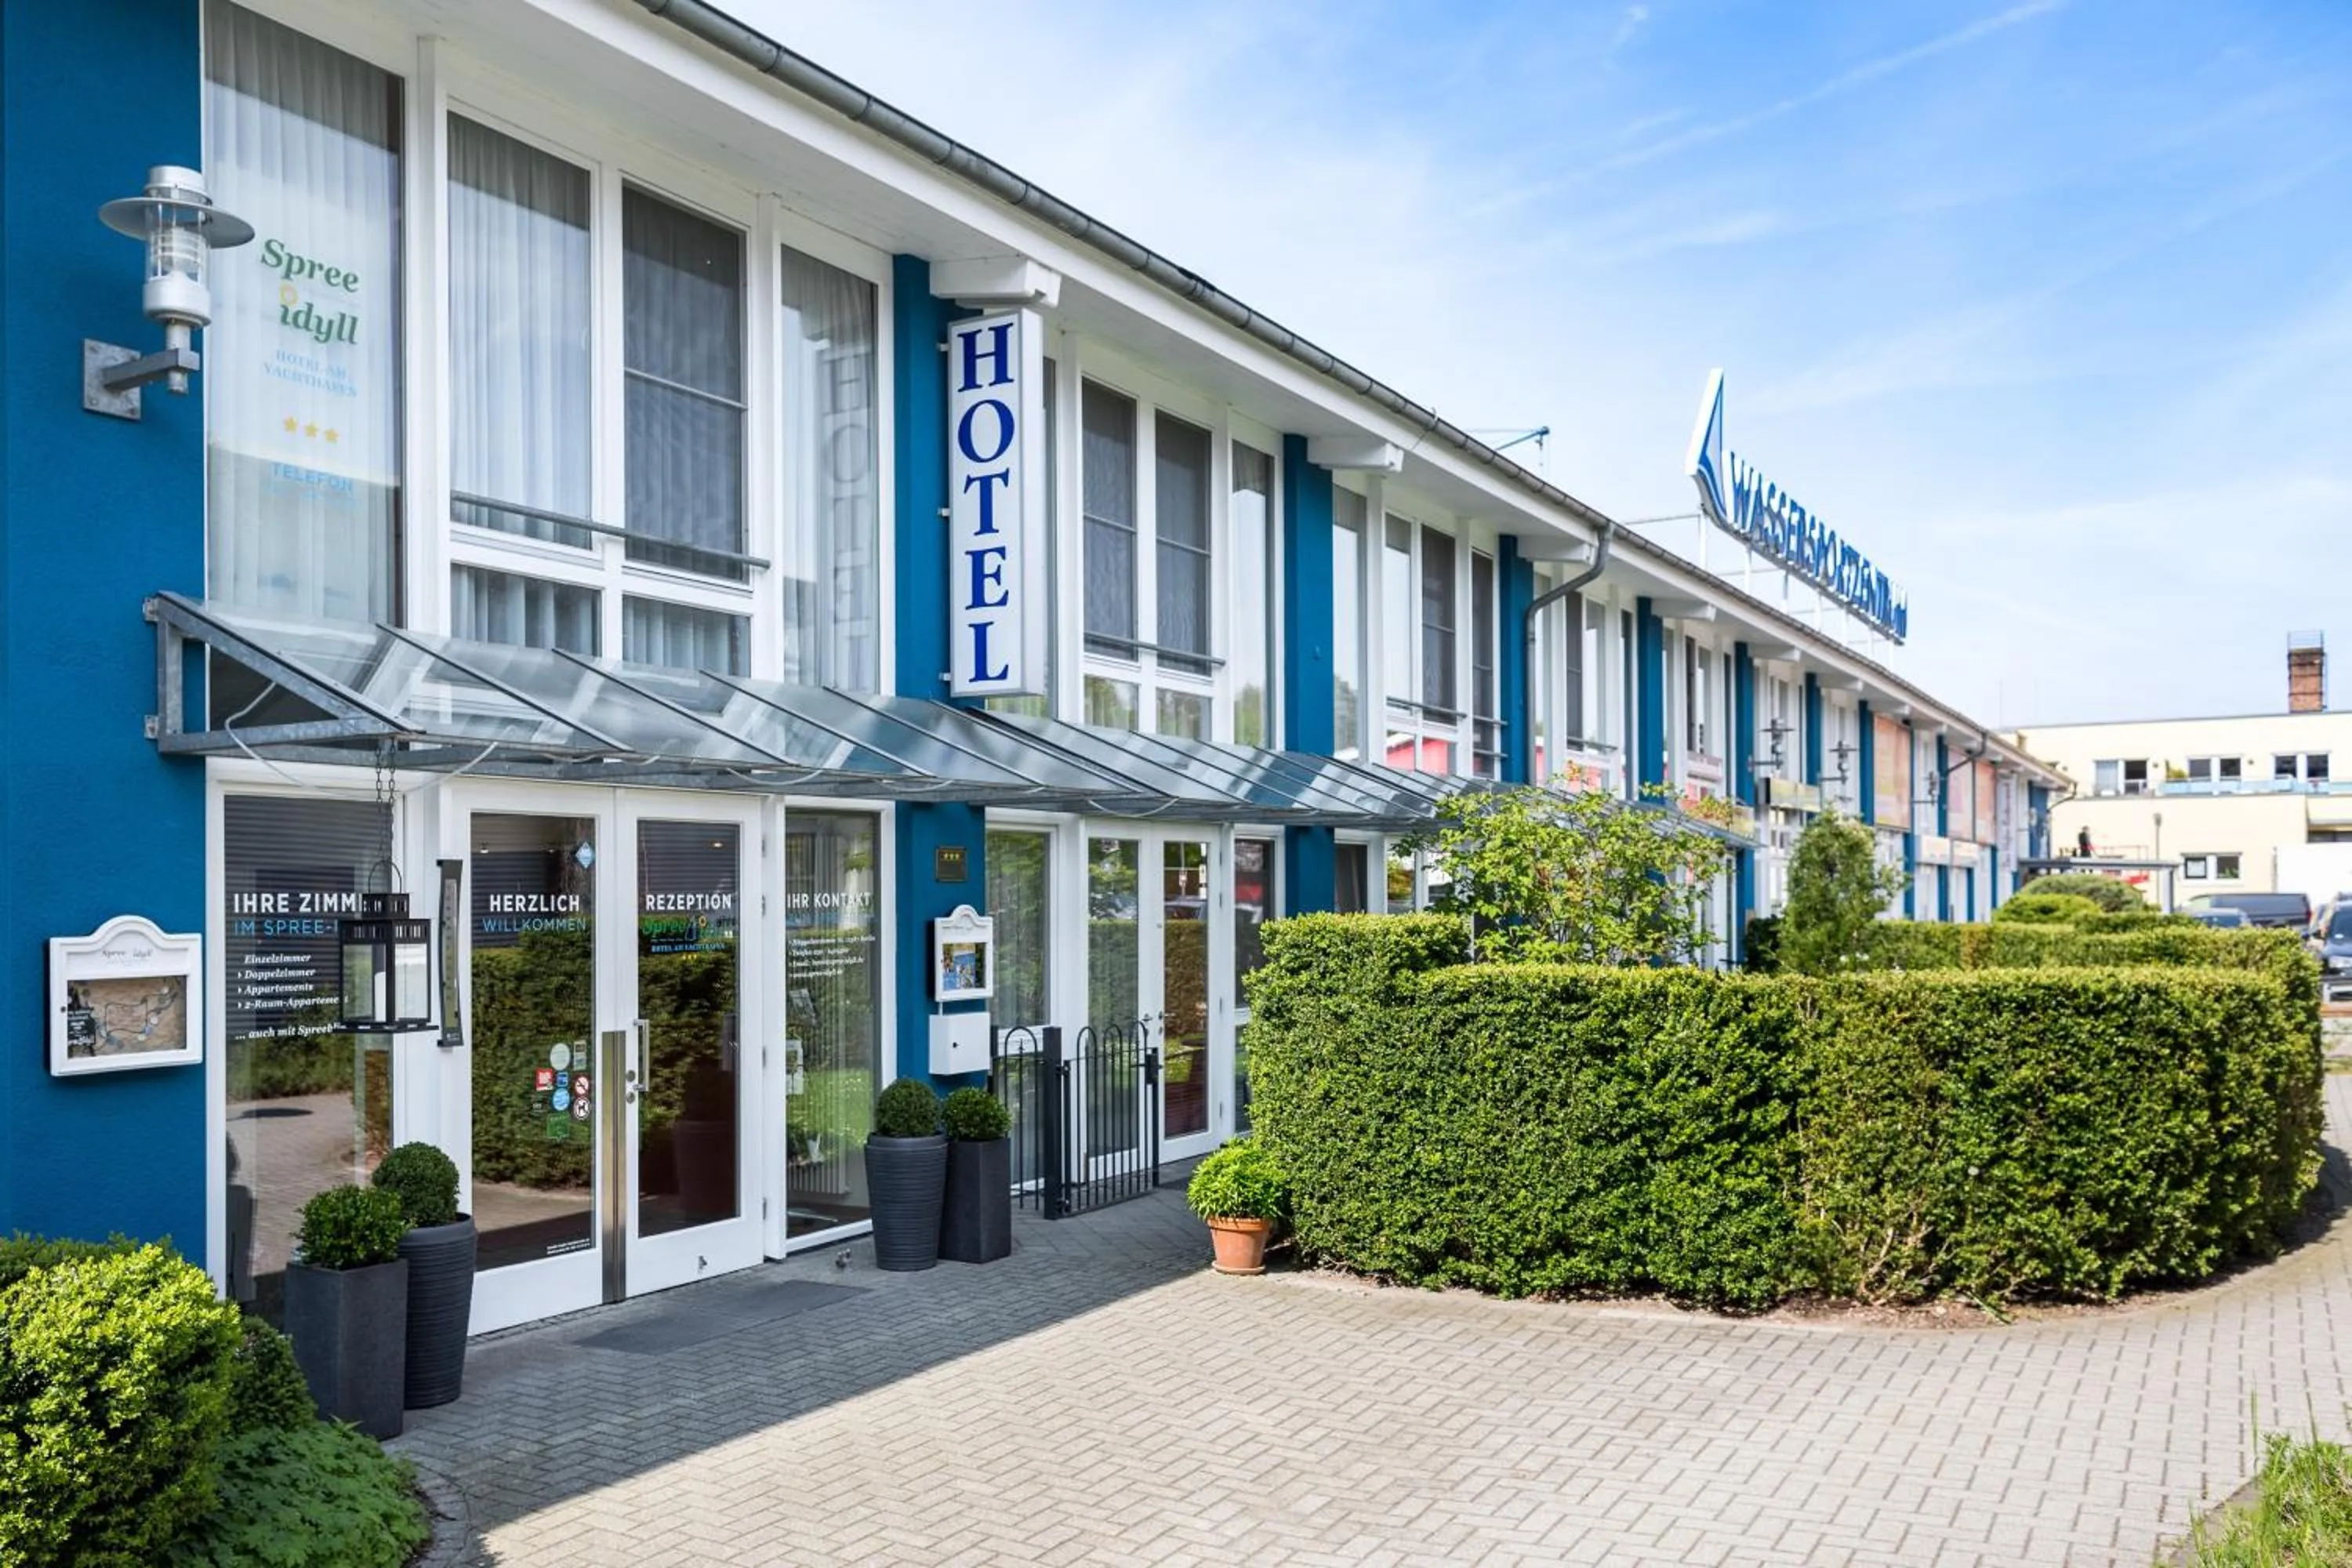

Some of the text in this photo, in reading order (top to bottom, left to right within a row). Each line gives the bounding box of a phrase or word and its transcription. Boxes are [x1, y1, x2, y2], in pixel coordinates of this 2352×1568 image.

[261, 238, 359, 293] Spree
[279, 301, 358, 344] idyll
[271, 461, 353, 492] TELEFON
[957, 322, 1014, 683] HOTEL
[234, 892, 363, 913] IHRE ZIMM
[489, 894, 580, 913] HERZLICH
[645, 894, 732, 911] REZEPTION
[786, 891, 872, 909] IHR KONTAKT
[235, 920, 255, 936] IM
[482, 917, 587, 933] WILLKOMMEN
[244, 953, 312, 965] Einzelzimmer
[244, 968, 316, 981] Doppelzimmer
[244, 983, 314, 996] Appartements
[248, 1026, 275, 1040] auch
[277, 1025, 296, 1036] mit
